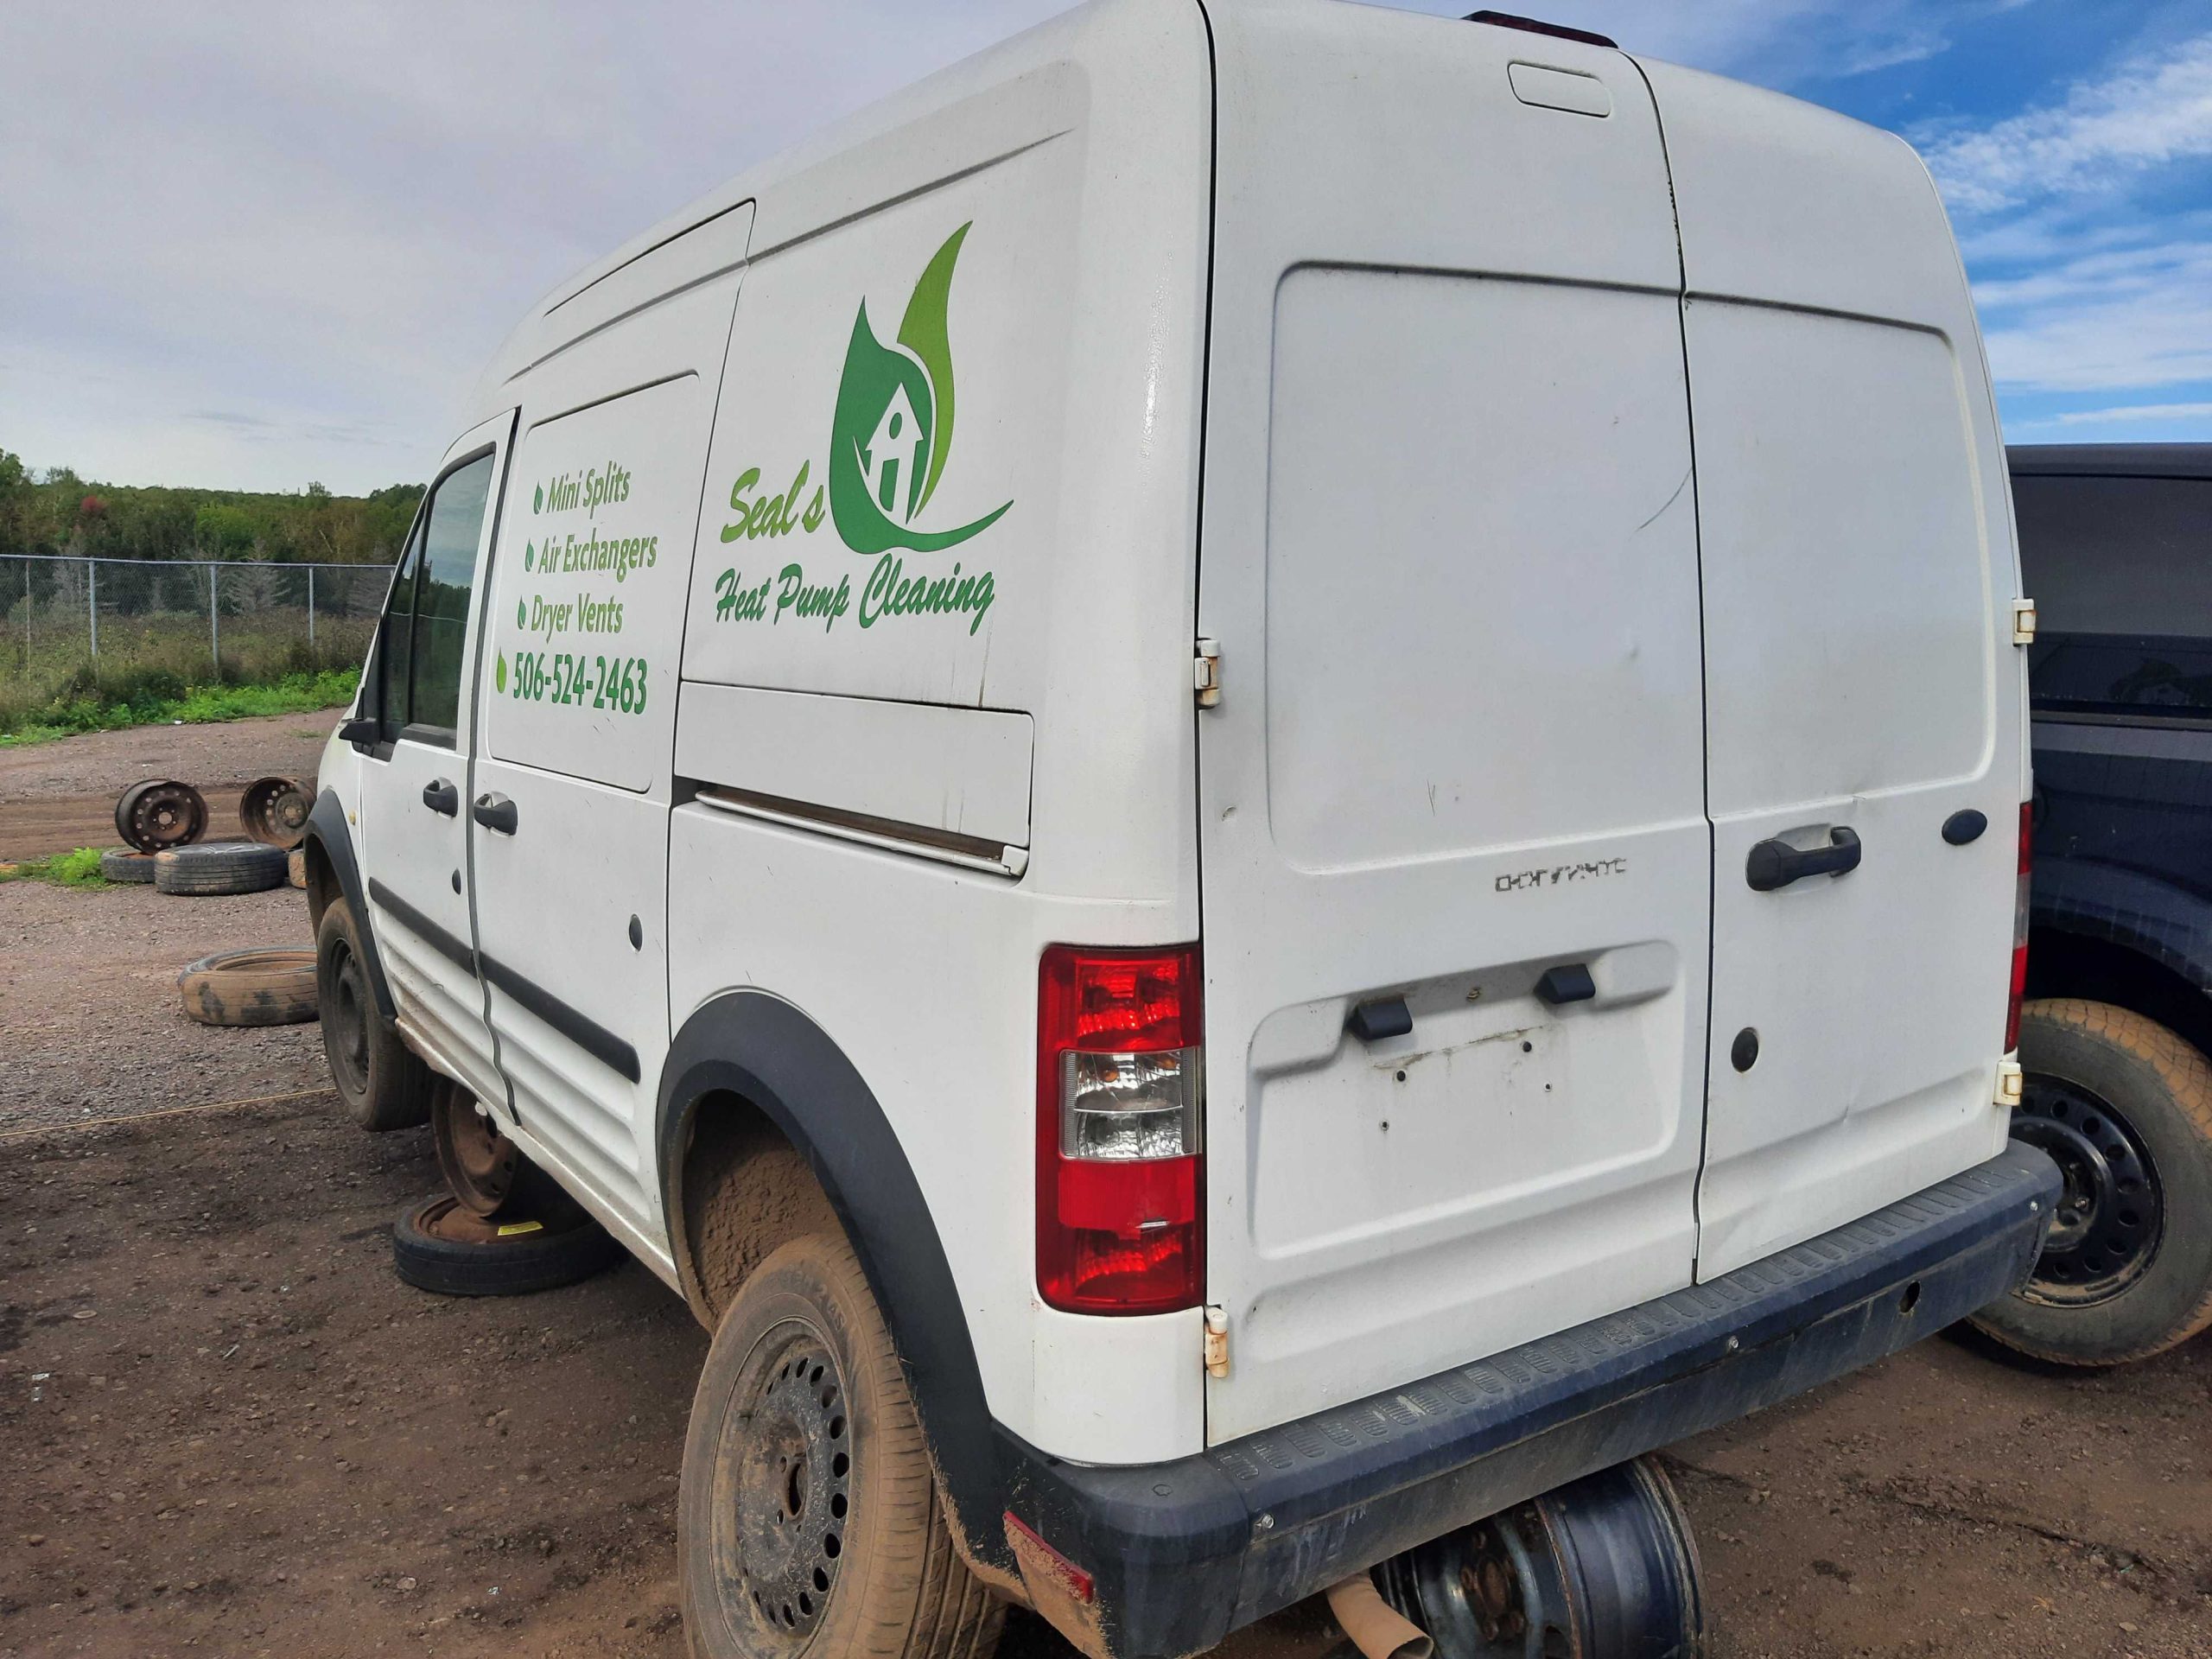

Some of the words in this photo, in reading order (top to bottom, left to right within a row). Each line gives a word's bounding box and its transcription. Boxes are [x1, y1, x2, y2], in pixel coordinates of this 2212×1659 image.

[547, 470, 582, 513] Mini
[582, 461, 631, 520] Splits
[537, 535, 561, 575] Air
[563, 528, 658, 582] Exchangers
[531, 594, 573, 644] Dryer
[578, 593, 623, 633] Vents
[715, 568, 772, 623] Heat
[774, 563, 850, 634] Pump
[859, 553, 995, 637] Cleaning
[513, 652, 648, 715] 506-524-2463
